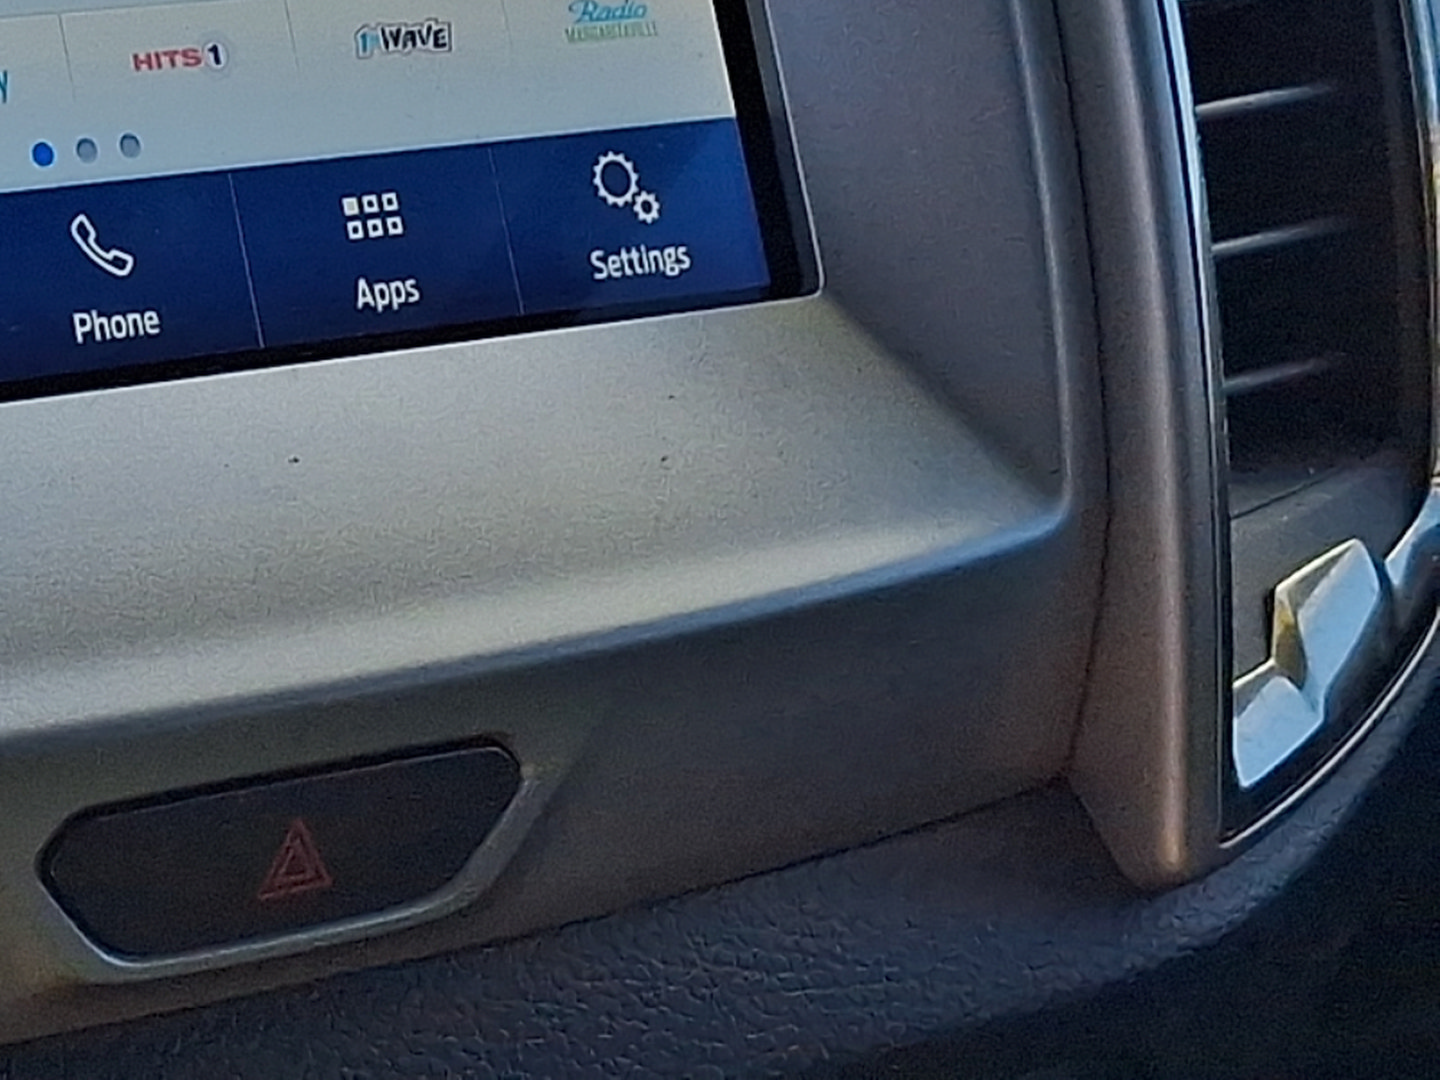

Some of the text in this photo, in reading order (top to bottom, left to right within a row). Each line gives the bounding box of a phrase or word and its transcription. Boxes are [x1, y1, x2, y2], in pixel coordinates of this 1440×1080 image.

[380, 23, 448, 51] WAVE
[132, 43, 222, 72] HITS 1
[590, 244, 691, 280] Settings
[356, 277, 420, 313] Apps
[72, 308, 161, 345] Phone
